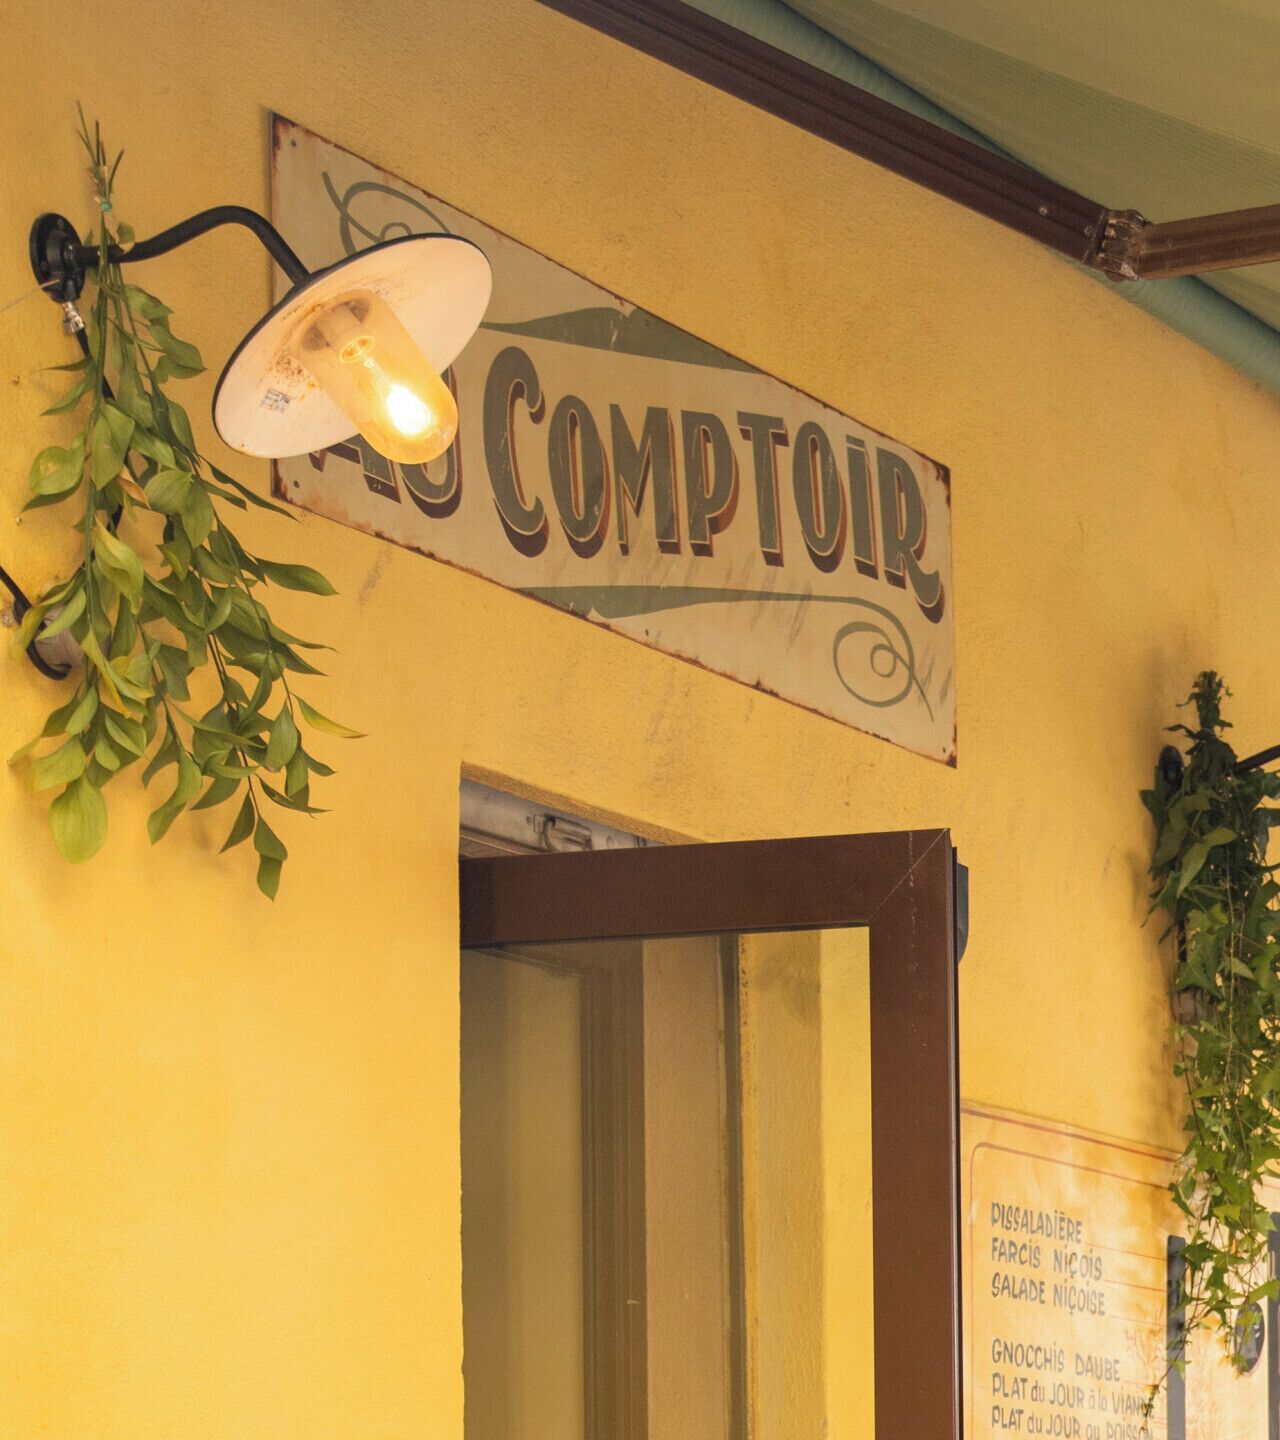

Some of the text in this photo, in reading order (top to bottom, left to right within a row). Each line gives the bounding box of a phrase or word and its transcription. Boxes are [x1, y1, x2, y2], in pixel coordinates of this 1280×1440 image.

[992, 1272, 1045, 1304] SALADE
[1075, 1353, 1120, 1382] DAUBE
[992, 1372, 1027, 1400] PLAT
[1031, 1380, 1045, 1403] du
[1049, 1382, 1084, 1409] JOUR
[1112, 1386, 1154, 1420] VIANE
[992, 1405, 1024, 1431] PLAT
[1027, 1411, 1042, 1434] du
[1046, 1413, 1081, 1439] JOUR
